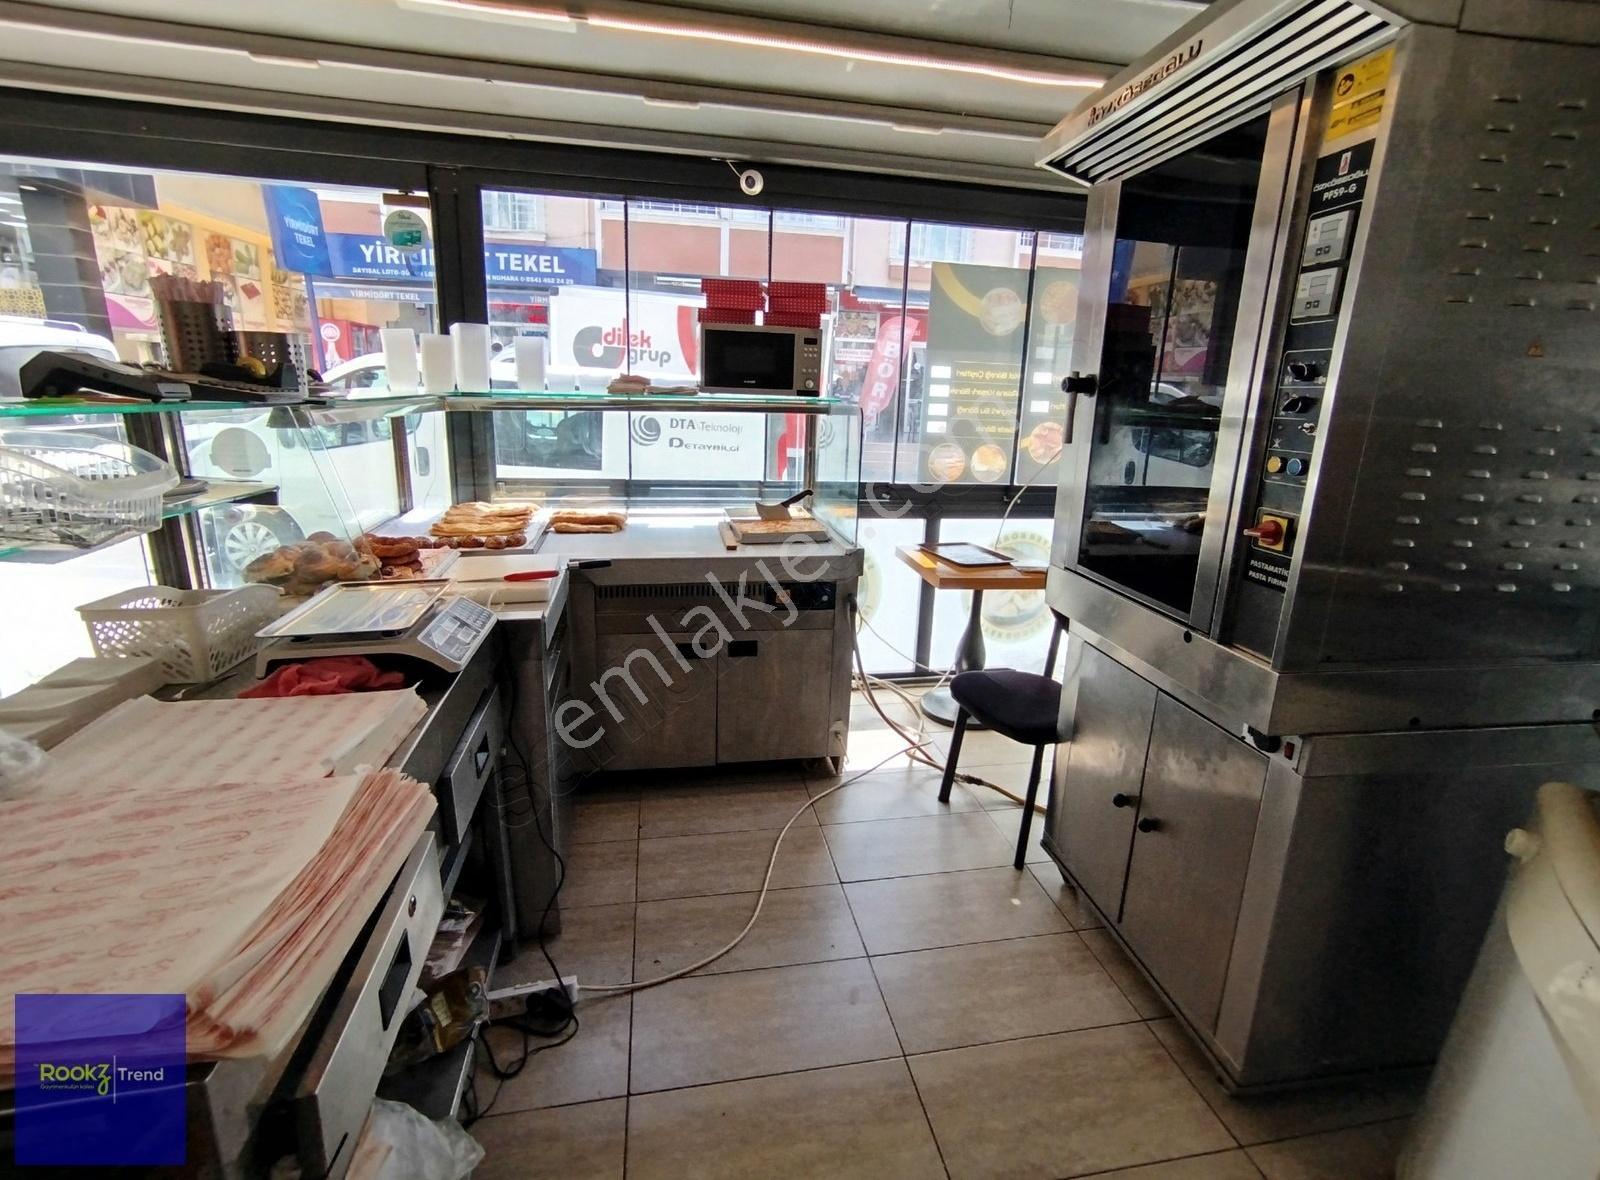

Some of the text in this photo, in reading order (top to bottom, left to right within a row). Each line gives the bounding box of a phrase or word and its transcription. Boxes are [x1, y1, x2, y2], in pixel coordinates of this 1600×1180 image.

[495, 252, 565, 273] TEKEL
[603, 318, 652, 348] dilek
[629, 348, 672, 367] grup
[669, 417, 696, 430] DTA
[1248, 570, 1267, 582] PASTA
